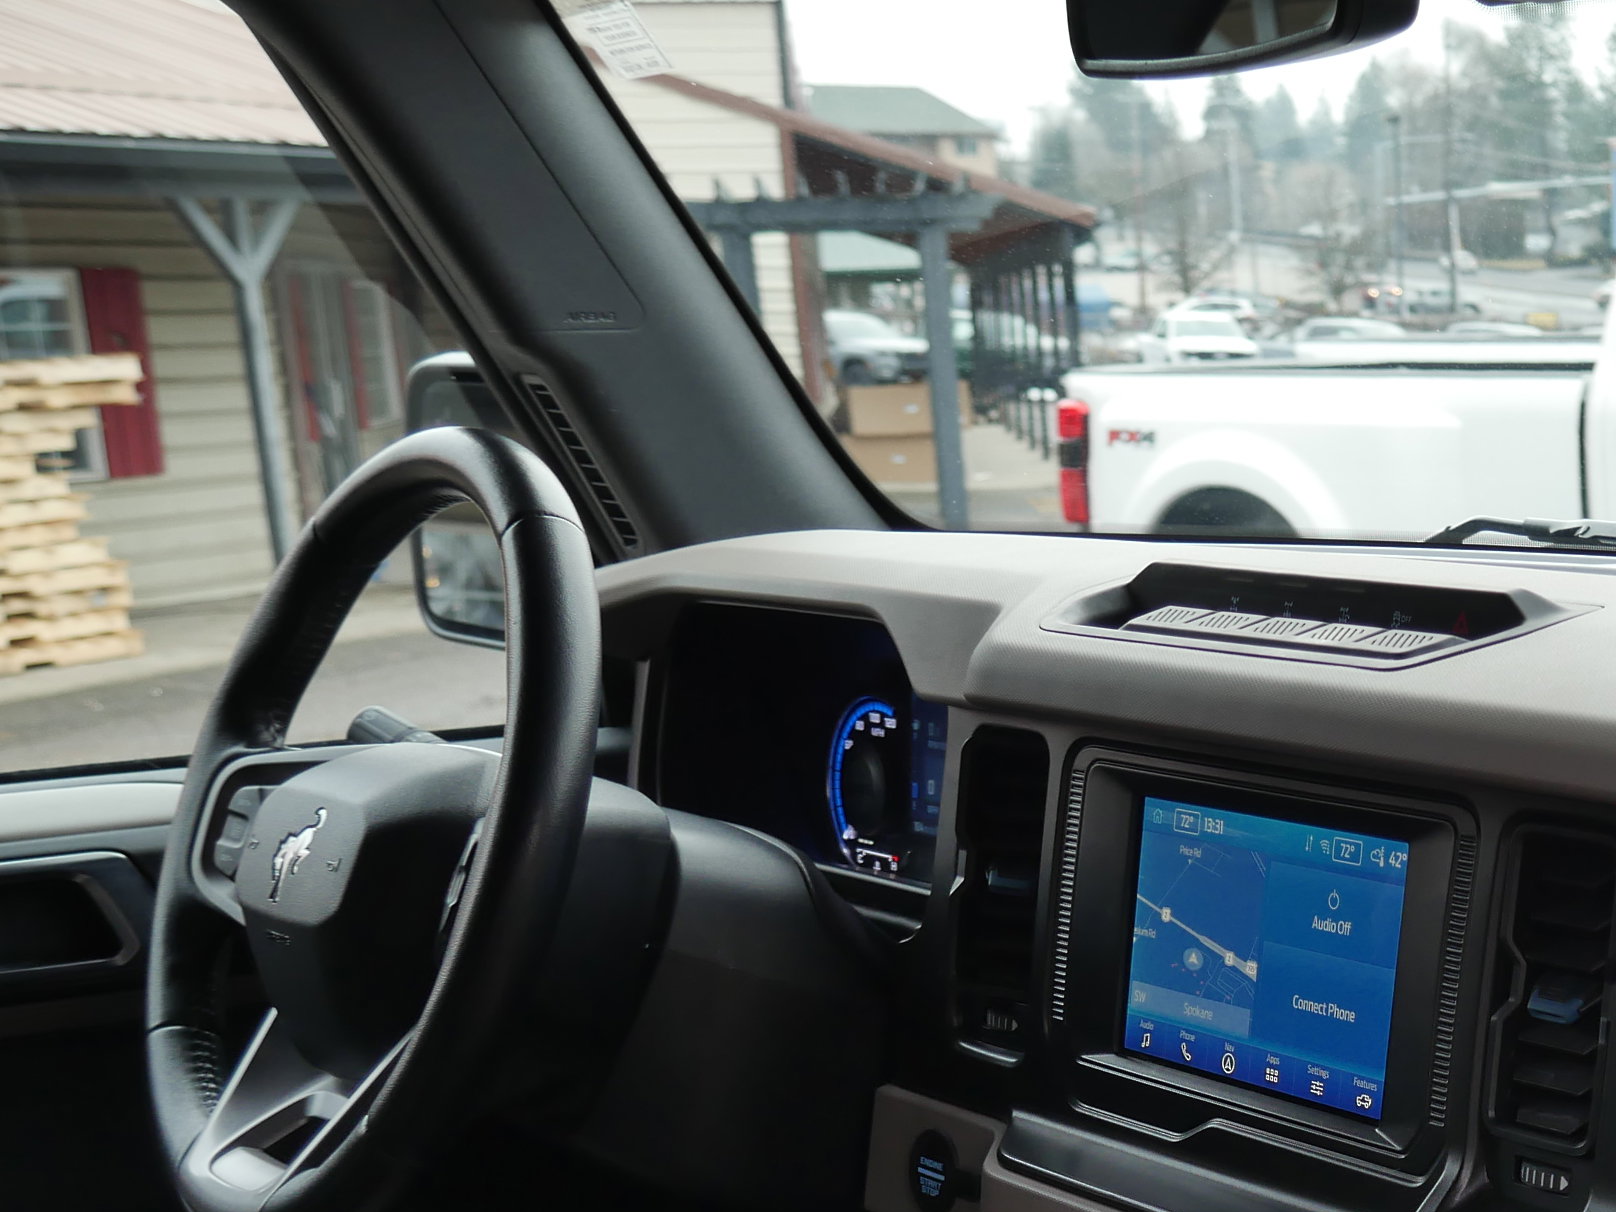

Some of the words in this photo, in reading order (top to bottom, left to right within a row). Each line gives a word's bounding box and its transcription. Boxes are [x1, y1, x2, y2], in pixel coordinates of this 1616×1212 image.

[562, 310, 617, 323] AIRBAG
[1107, 430, 1154, 447] FX4
[1180, 813, 1194, 829] 72°
[1204, 817, 1224, 835] 13:31
[1179, 845, 1193, 857] Price
[1193, 847, 1202, 858] Rd
[1340, 843, 1355, 859] 72°
[1389, 851, 1408, 869] 42°
[1311, 915, 1337, 934] Audio
[1337, 920, 1352, 936] Off
[1134, 990, 1146, 1003] SW
[1183, 1002, 1213, 1019] Spokane
[1292, 995, 1328, 1017] Connect
[1328, 1003, 1356, 1023] Phone
[1139, 1018, 1154, 1031] Audio
[1180, 1030, 1195, 1042] Phone
[1225, 1041, 1235, 1052] Nav
[1266, 1053, 1280, 1067] Apps
[1307, 1065, 1330, 1080] Settings
[1353, 1077, 1378, 1092] Features
[920, 1176, 942, 1190] START
[921, 1185, 940, 1197] STOP
